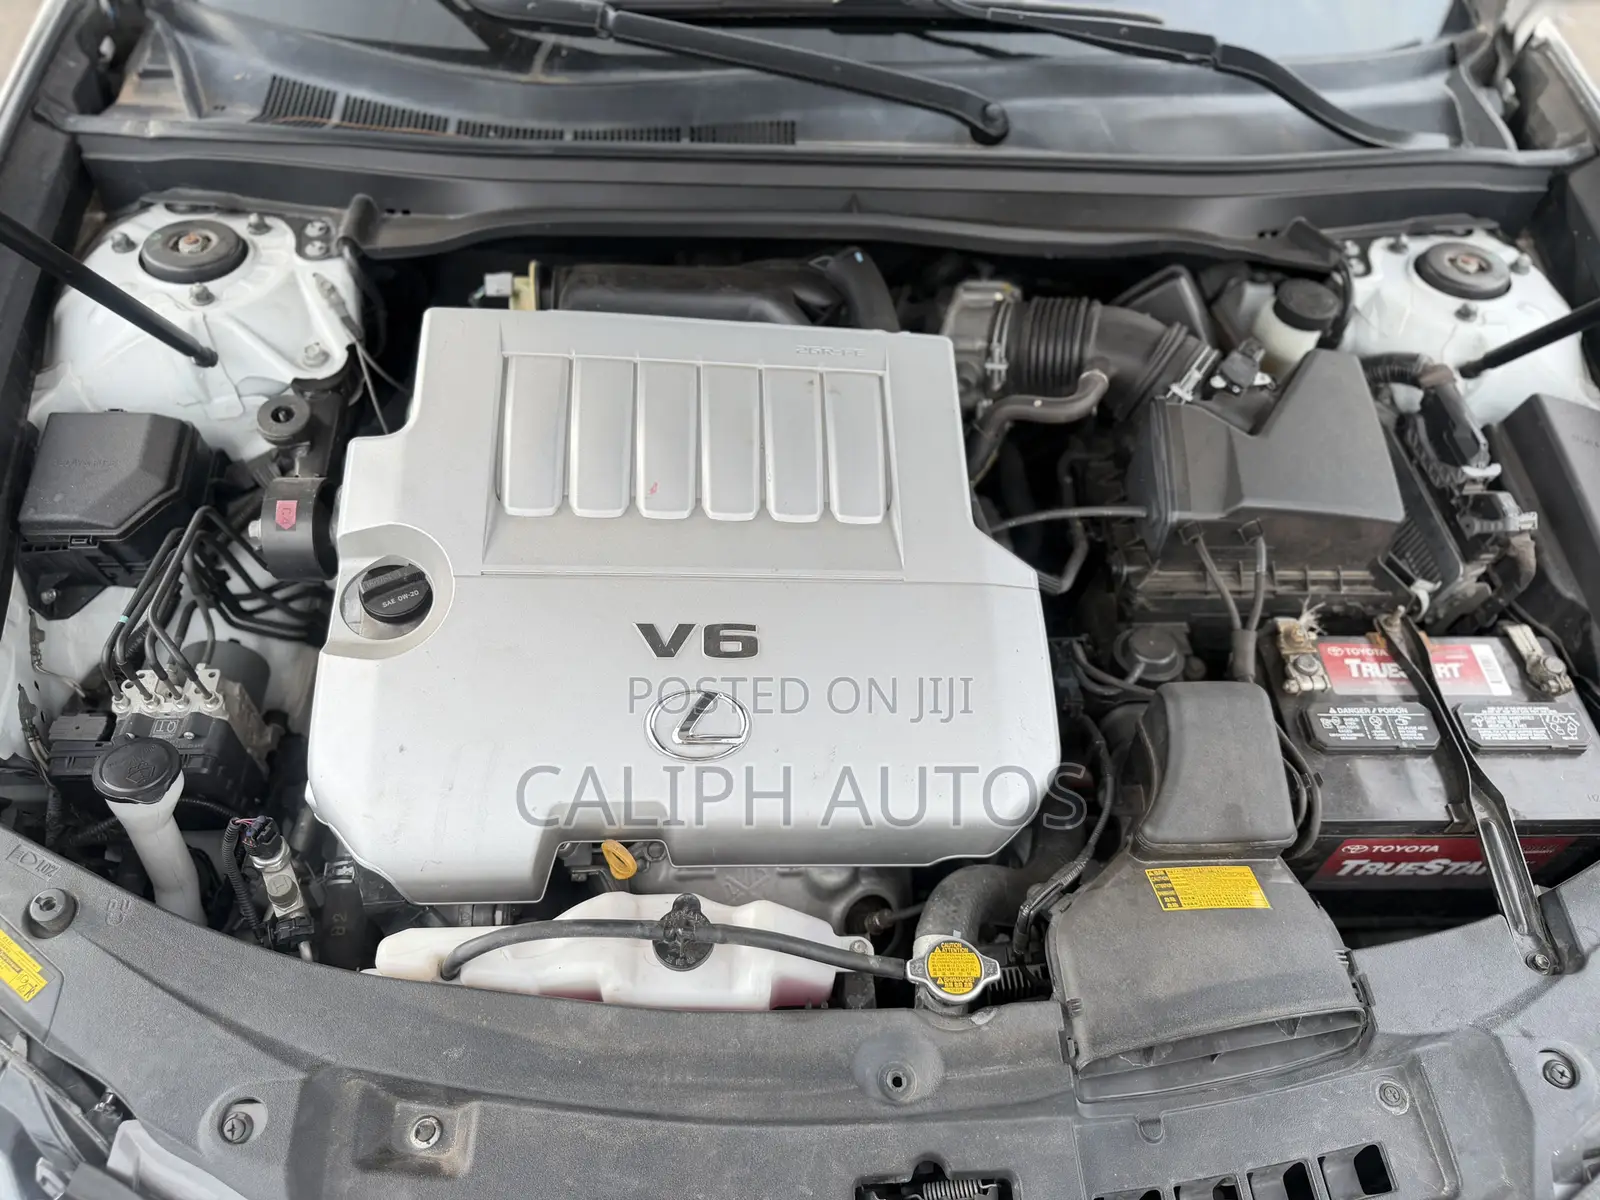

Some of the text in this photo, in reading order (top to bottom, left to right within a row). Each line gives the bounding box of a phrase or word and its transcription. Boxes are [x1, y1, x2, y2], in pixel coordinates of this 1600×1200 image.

[382, 589, 420, 608] SAE 0W-20
[632, 622, 760, 660] V6
[1345, 647, 1389, 657] TOYOTA
[1371, 844, 1439, 853] TOYOTA
